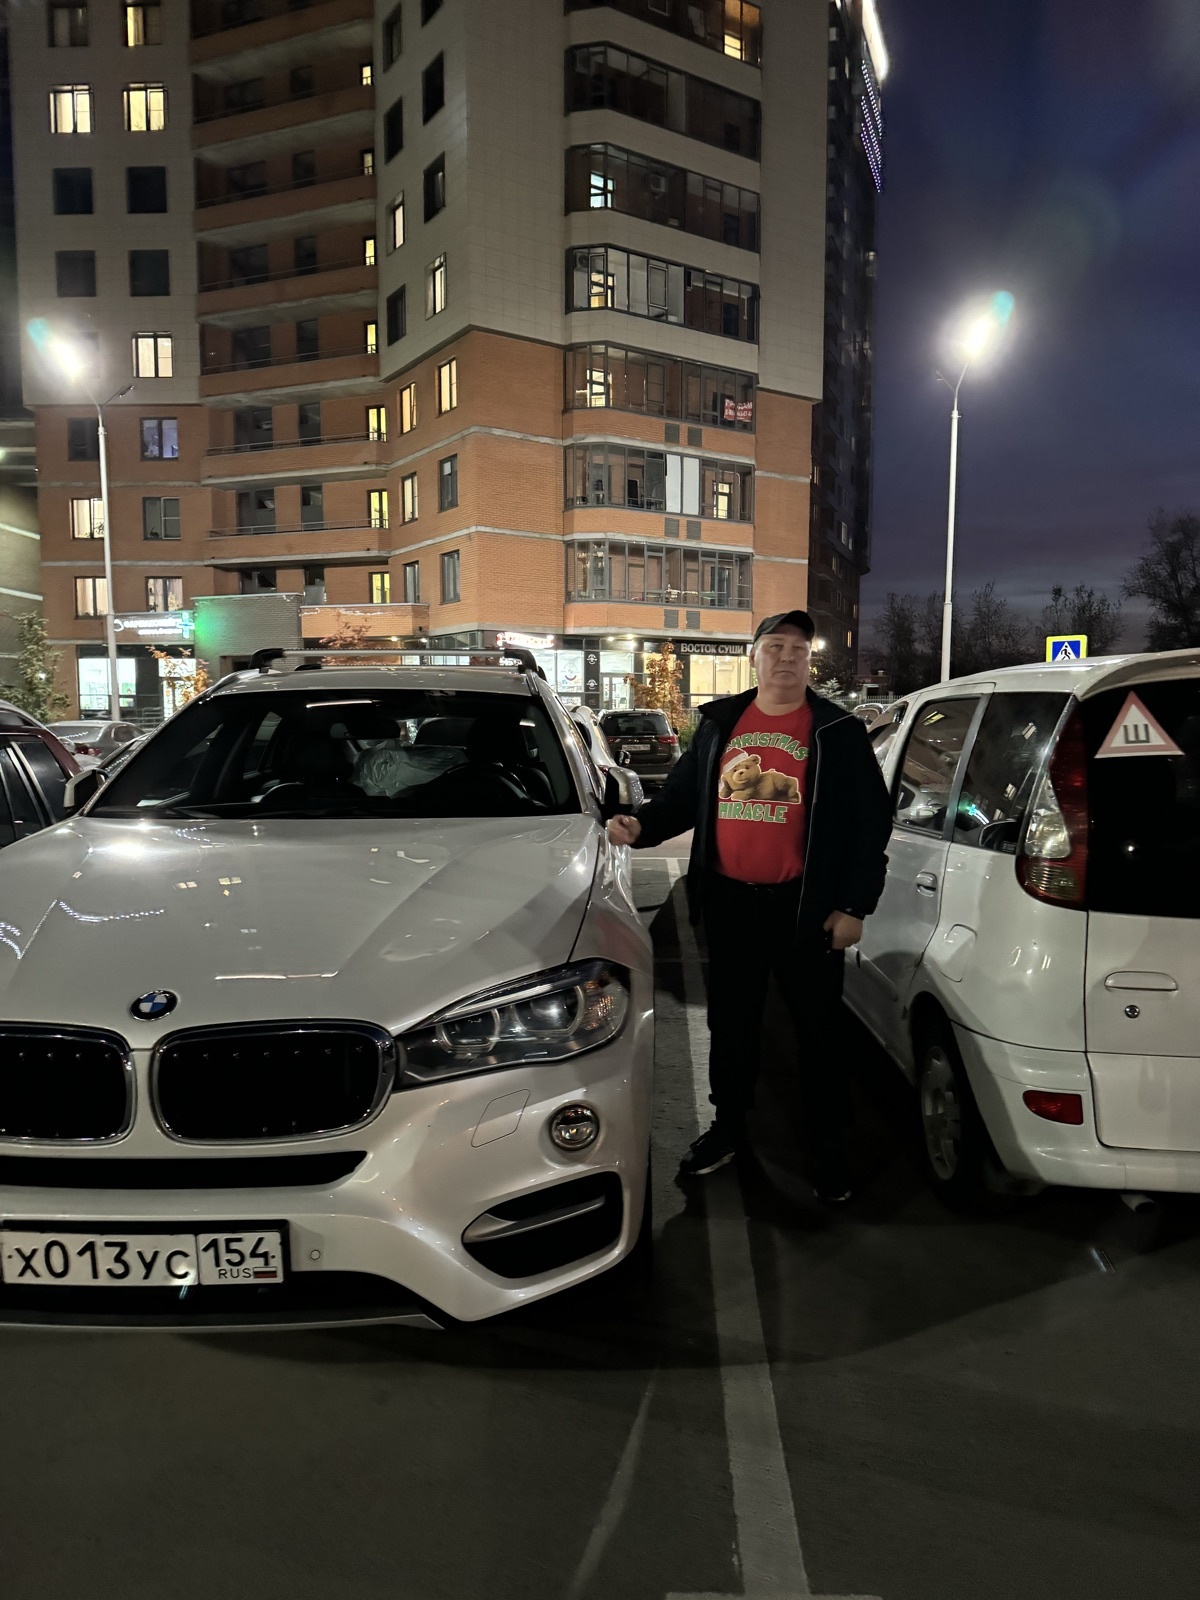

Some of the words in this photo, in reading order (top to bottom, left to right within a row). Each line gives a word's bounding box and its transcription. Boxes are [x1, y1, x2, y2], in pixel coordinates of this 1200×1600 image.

[680, 643, 717, 653] ВОСТОК
[718, 644, 744, 654] СУШИ
[1122, 723, 1151, 744] Ш
[718, 802, 787, 823] MIRACLE
[201, 1237, 270, 1267] 154
[218, 1267, 252, 1279] RUS
